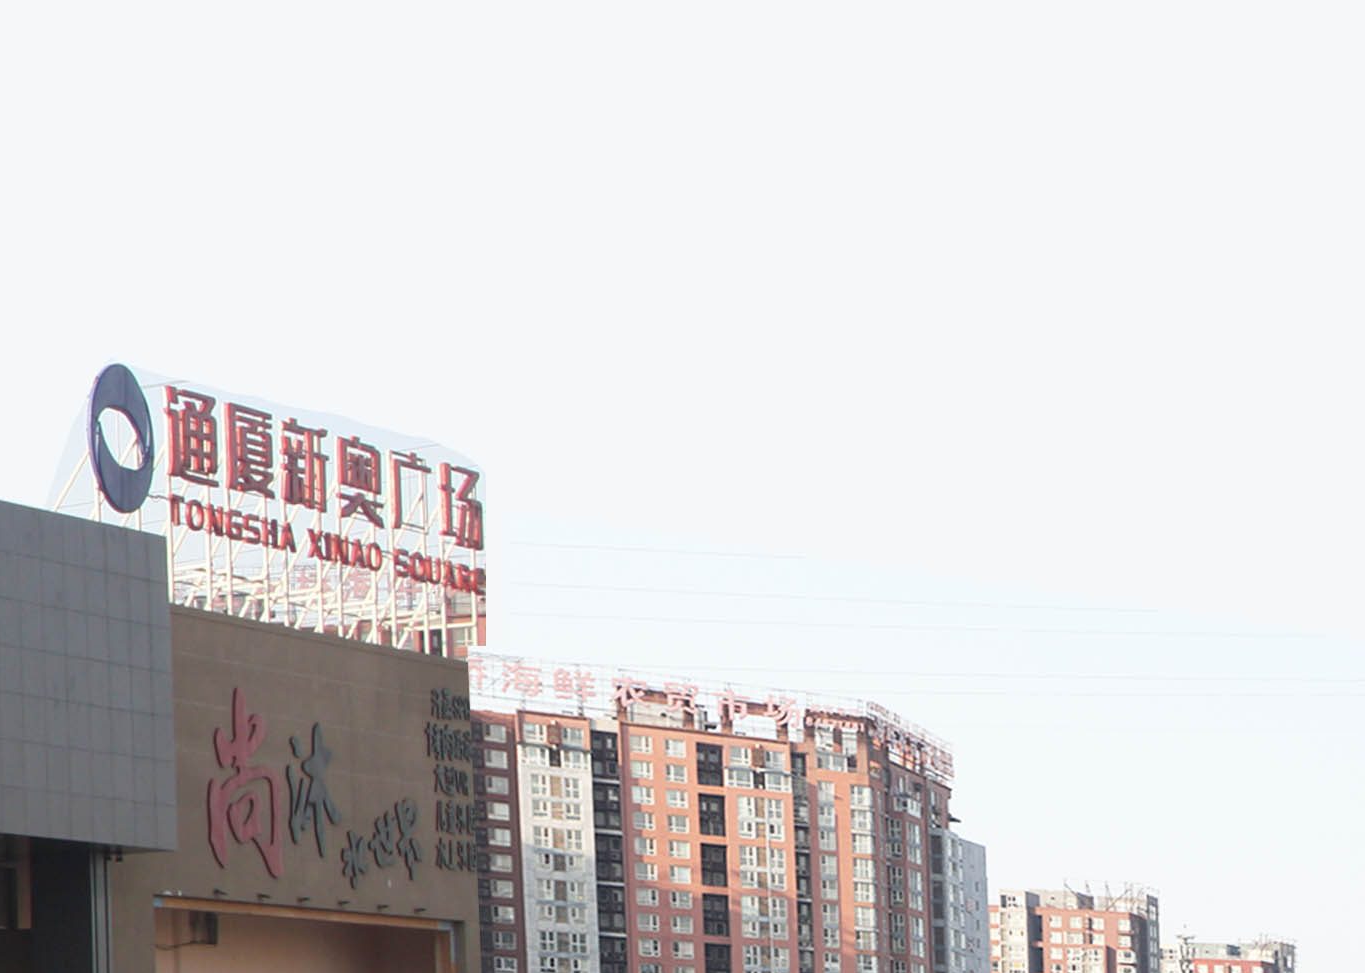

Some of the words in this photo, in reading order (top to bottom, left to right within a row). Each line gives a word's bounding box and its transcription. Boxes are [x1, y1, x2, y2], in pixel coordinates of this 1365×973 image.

[165, 385, 484, 551] 通厦新奥广场
[169, 494, 296, 553] TONGSHA
[307, 528, 383, 572] XINAO
